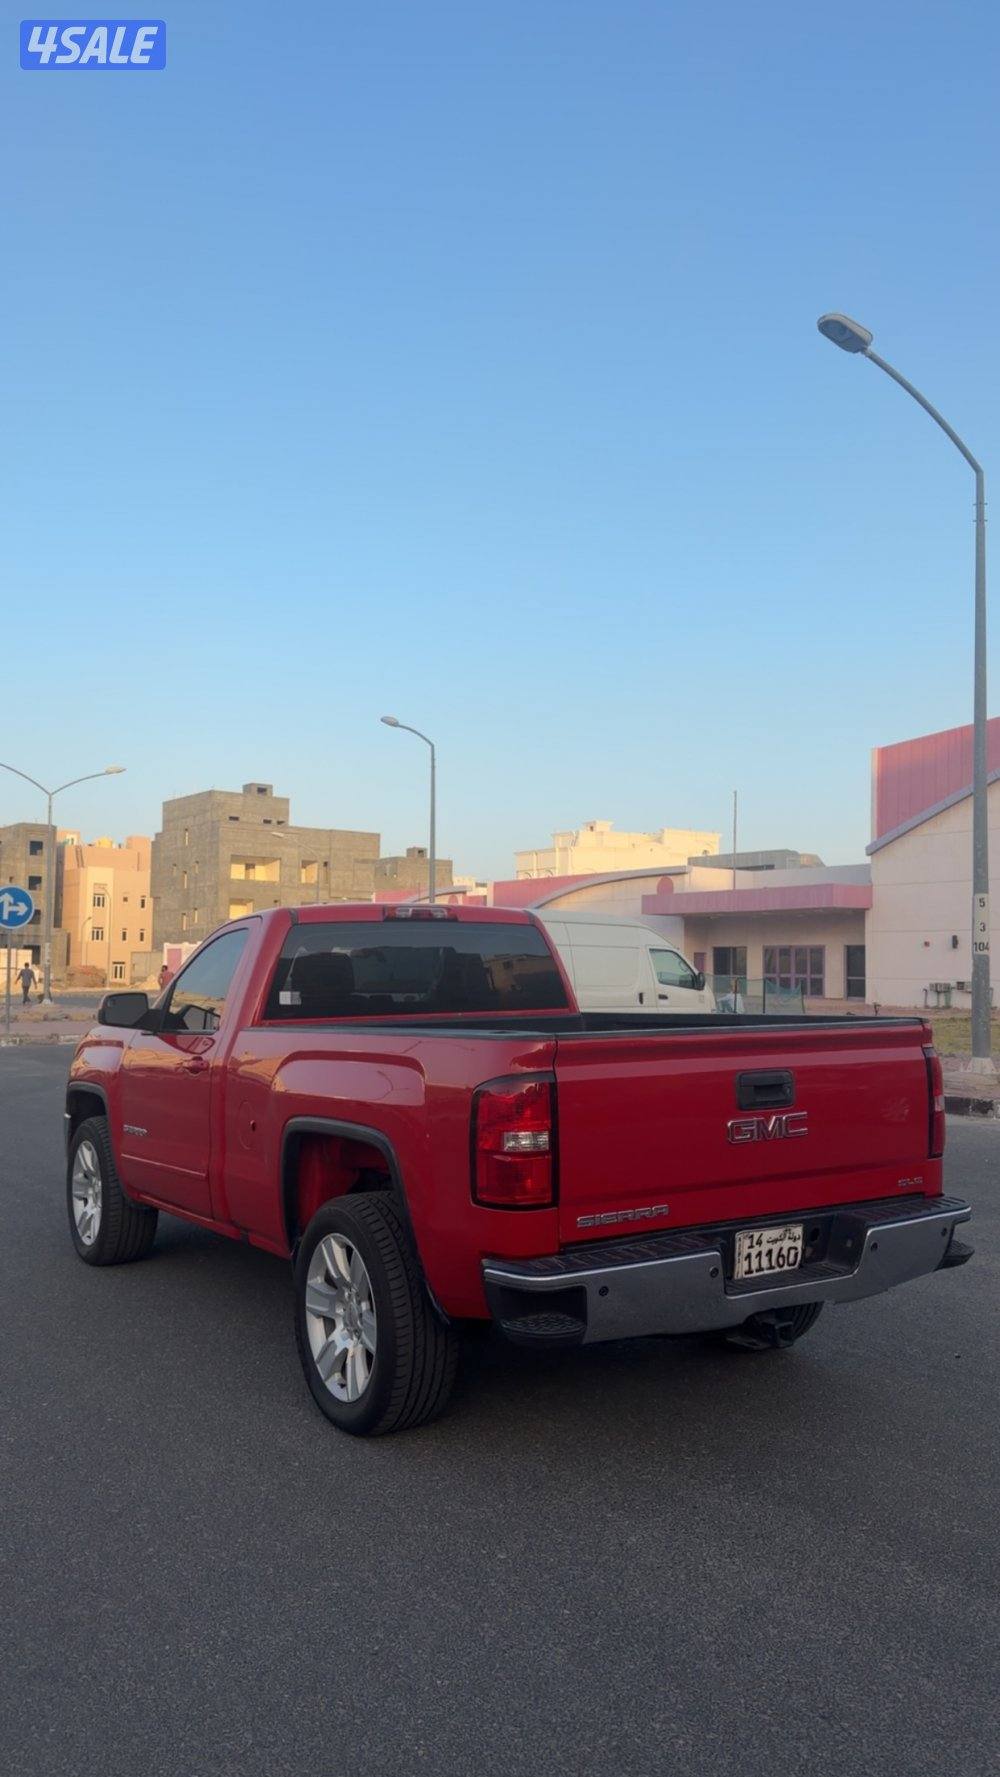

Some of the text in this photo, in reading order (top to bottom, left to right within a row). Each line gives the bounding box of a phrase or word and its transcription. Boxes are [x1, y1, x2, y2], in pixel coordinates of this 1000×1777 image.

[979, 897, 986, 908] 5
[979, 922, 986, 933] 3
[974, 942, 989, 952] 104
[727, 1111, 808, 1144] GMC
[576, 1204, 669, 1228] SIERRA
[748, 1233, 763, 1249] 14
[744, 1247, 799, 1275] 11160
